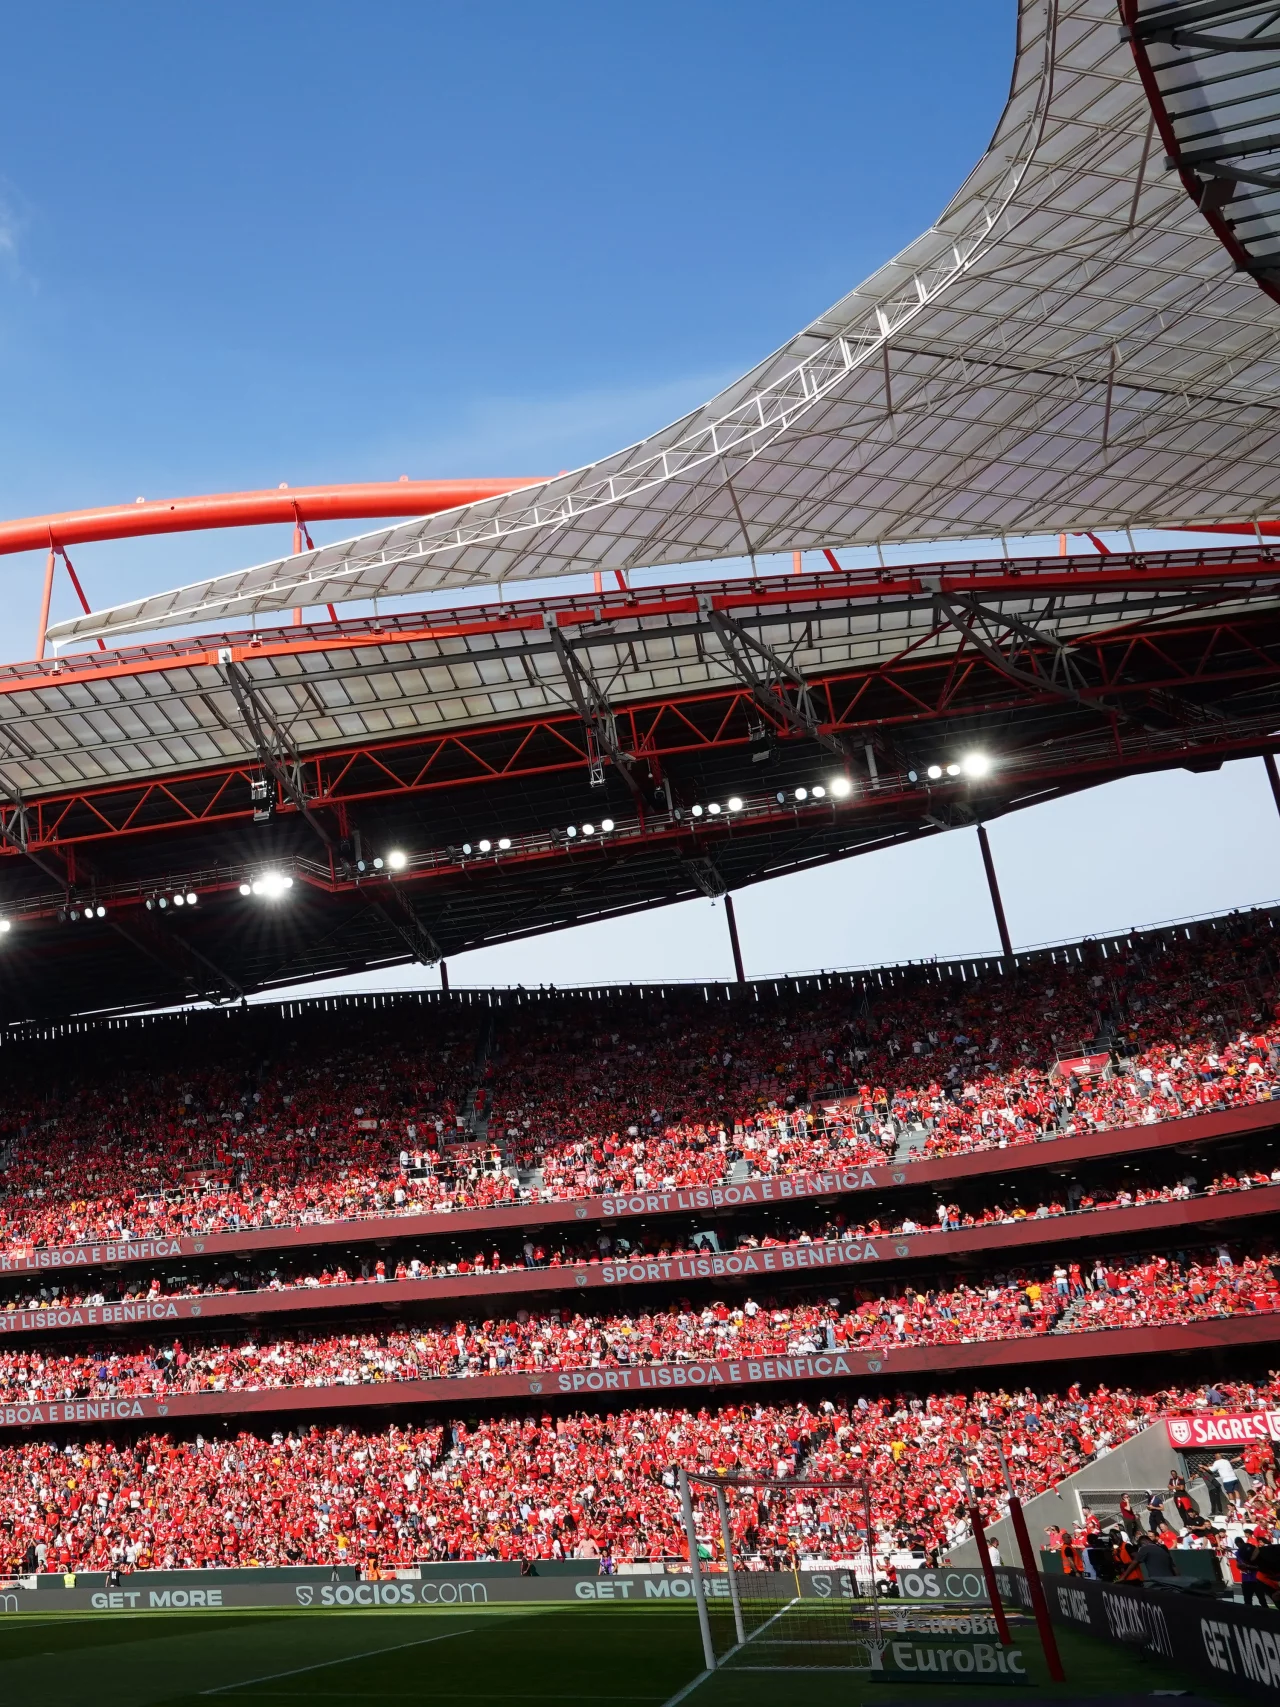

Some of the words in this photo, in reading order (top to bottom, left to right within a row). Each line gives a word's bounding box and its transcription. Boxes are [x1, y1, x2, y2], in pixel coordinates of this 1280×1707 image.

[602, 1194, 671, 1215] SPORT
[678, 1186, 756, 1208] LISBOA
[762, 1183, 773, 1199] E
[780, 1171, 876, 1196] BENFICA
[26, 1250, 88, 1268] LISBOA
[92, 1247, 100, 1262] E
[106, 1240, 181, 1260] BENFICA
[602, 1262, 671, 1282] SPORT
[679, 1254, 759, 1276] LISBOA
[765, 1250, 775, 1269] E
[783, 1243, 879, 1267] BENFICA
[21, 1311, 83, 1328] LISBOA
[88, 1310, 96, 1323] E
[102, 1303, 178, 1322] BENFICA
[558, 1371, 631, 1391] SPORT
[639, 1366, 723, 1387] LISBOA
[730, 1362, 741, 1381] E
[749, 1357, 851, 1380] BENFICA
[50, 1406, 58, 1421] E
[64, 1401, 144, 1420] BENFICA
[1193, 1415, 1269, 1443] SAGRES
[91, 1592, 140, 1608] GET
[149, 1589, 222, 1607] MORE
[320, 1582, 488, 1606] SOCIOS.com
[575, 1581, 634, 1599] GET
[912, 1613, 999, 1635] EuroBi
[891, 1642, 1026, 1674] EuroBic
[1201, 1617, 1237, 1675] GET
[1233, 1623, 1280, 1690] MOR
